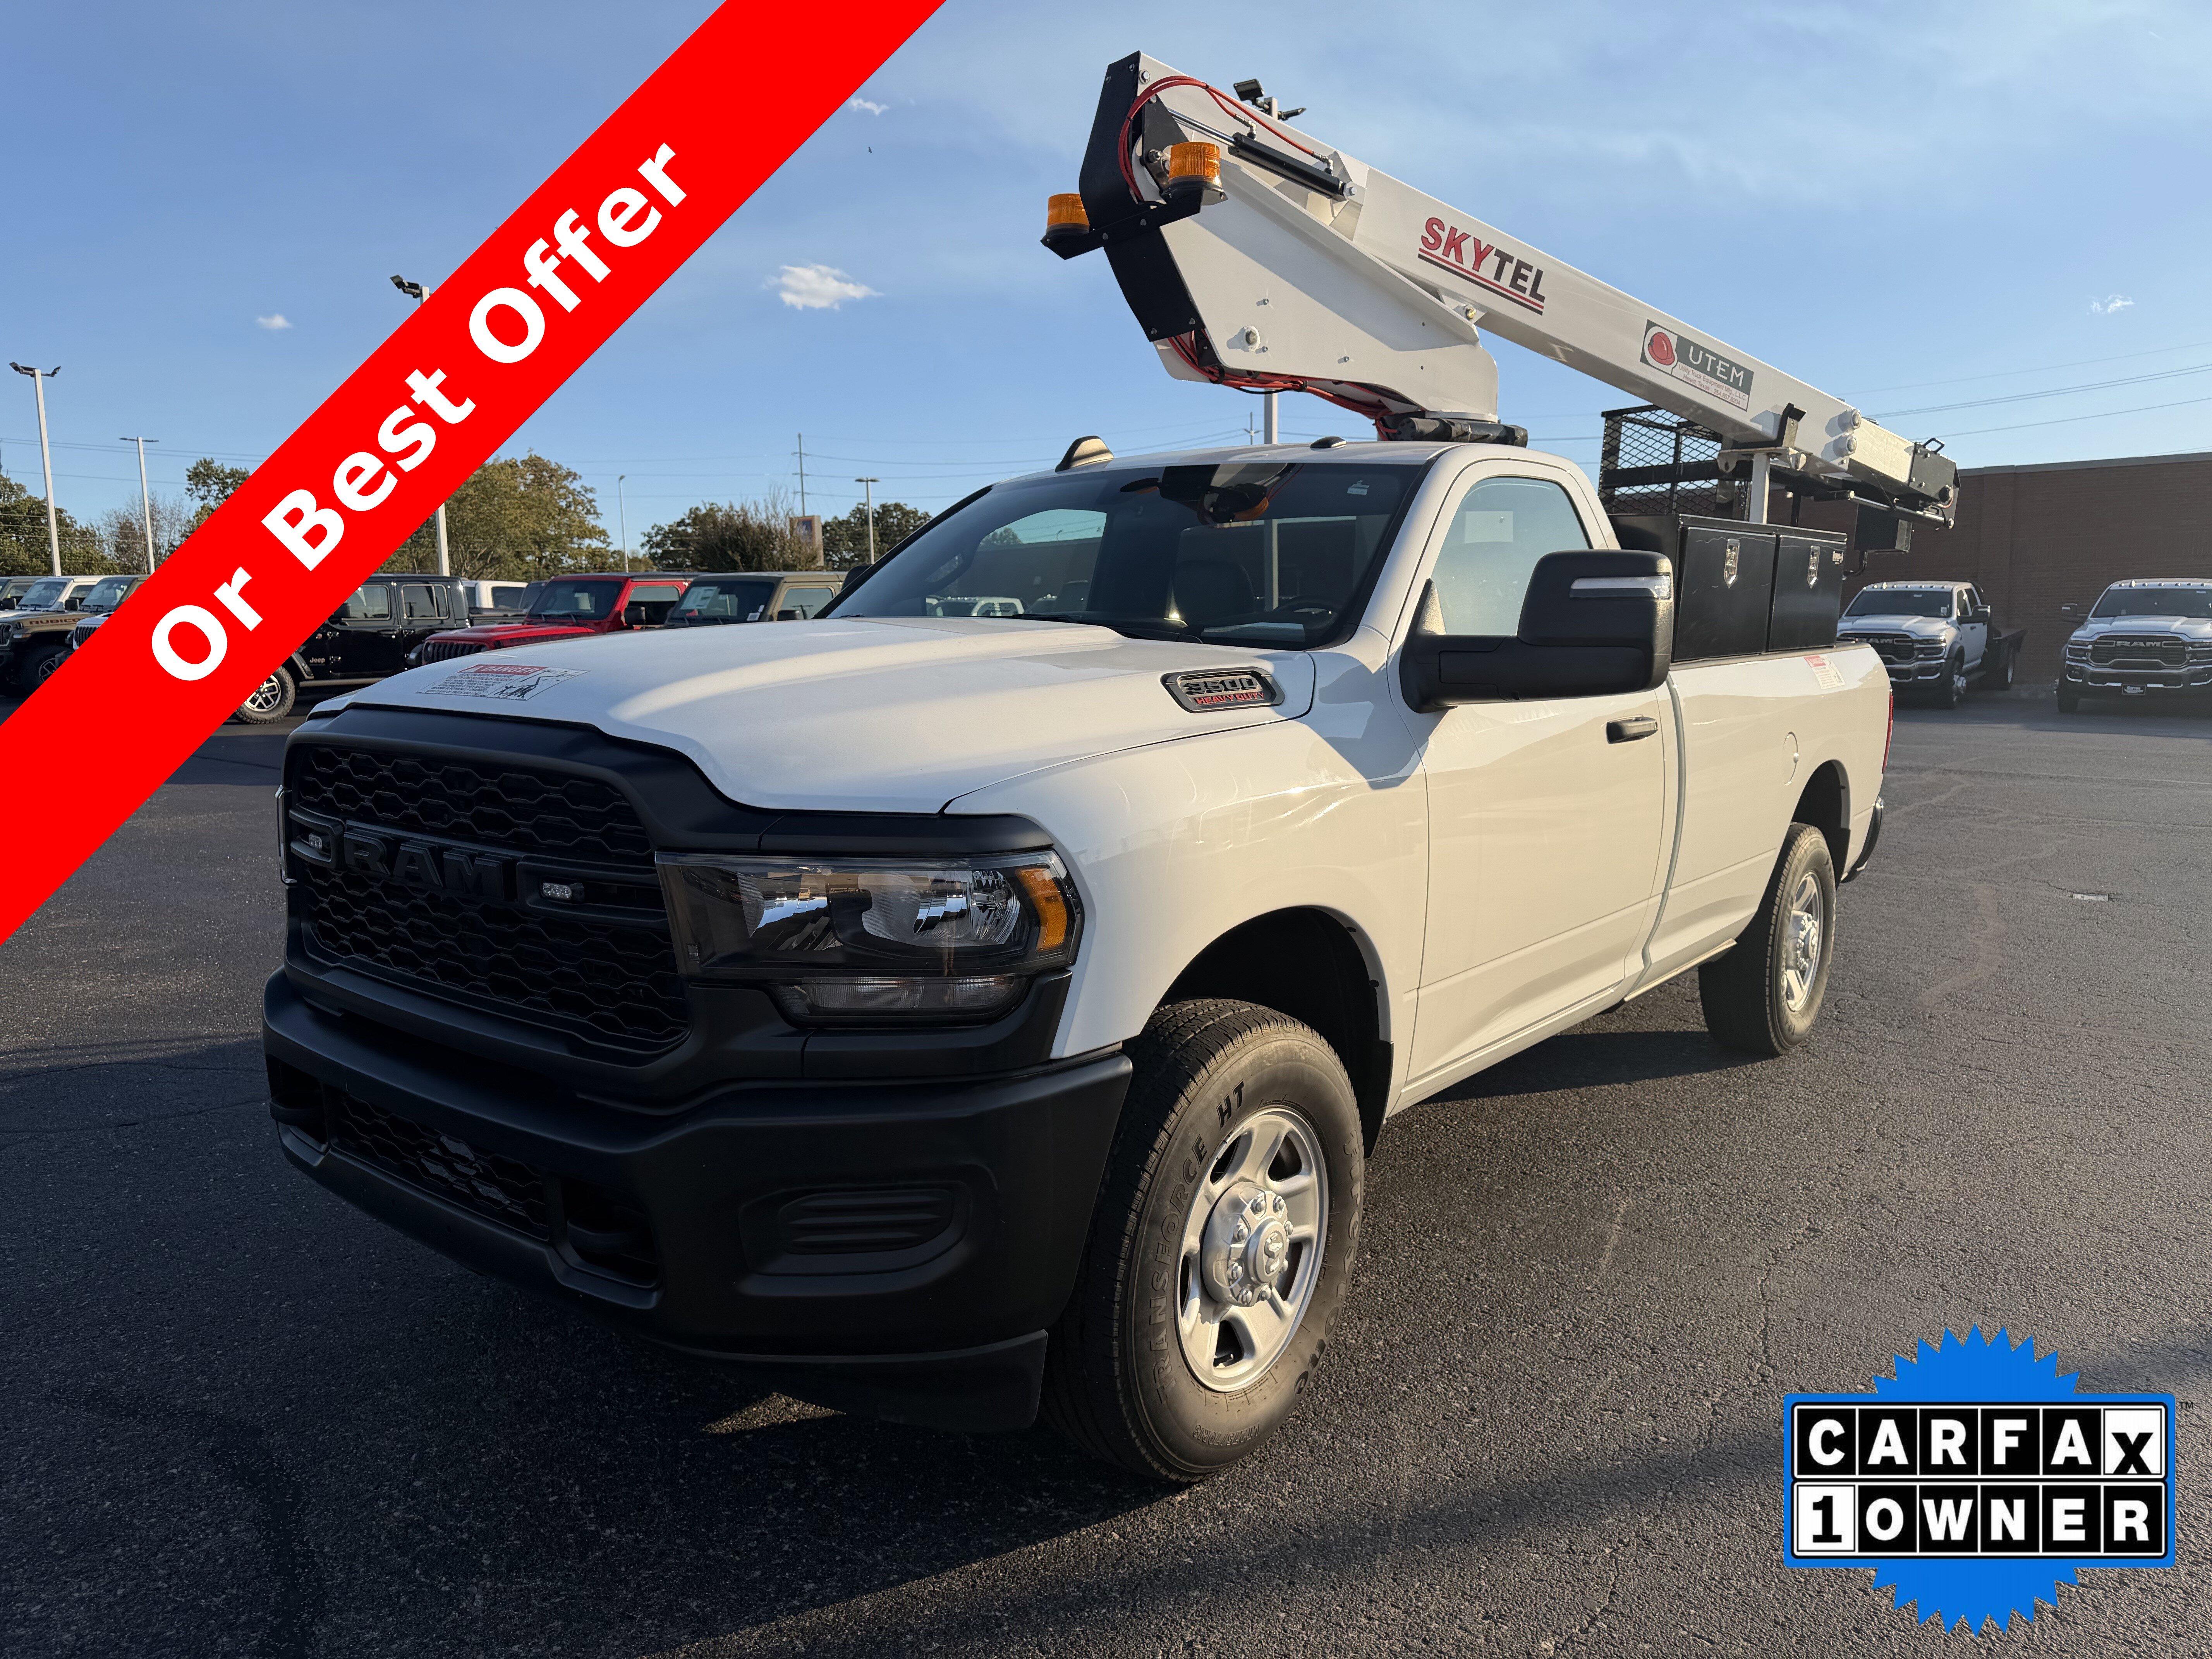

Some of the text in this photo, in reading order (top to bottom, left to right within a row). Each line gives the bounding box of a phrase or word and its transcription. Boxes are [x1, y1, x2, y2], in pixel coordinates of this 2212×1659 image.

[1421, 217, 1545, 303] SKYTEL
[1689, 346, 1744, 386] UTEM
[481, 666, 539, 674] DANGER
[1183, 678, 1258, 695] 3500
[1194, 692, 1264, 704] HEAVY DUTY
[344, 831, 505, 899] RAM
[1149, 1079, 1245, 1404] TRANSFORCE HT
